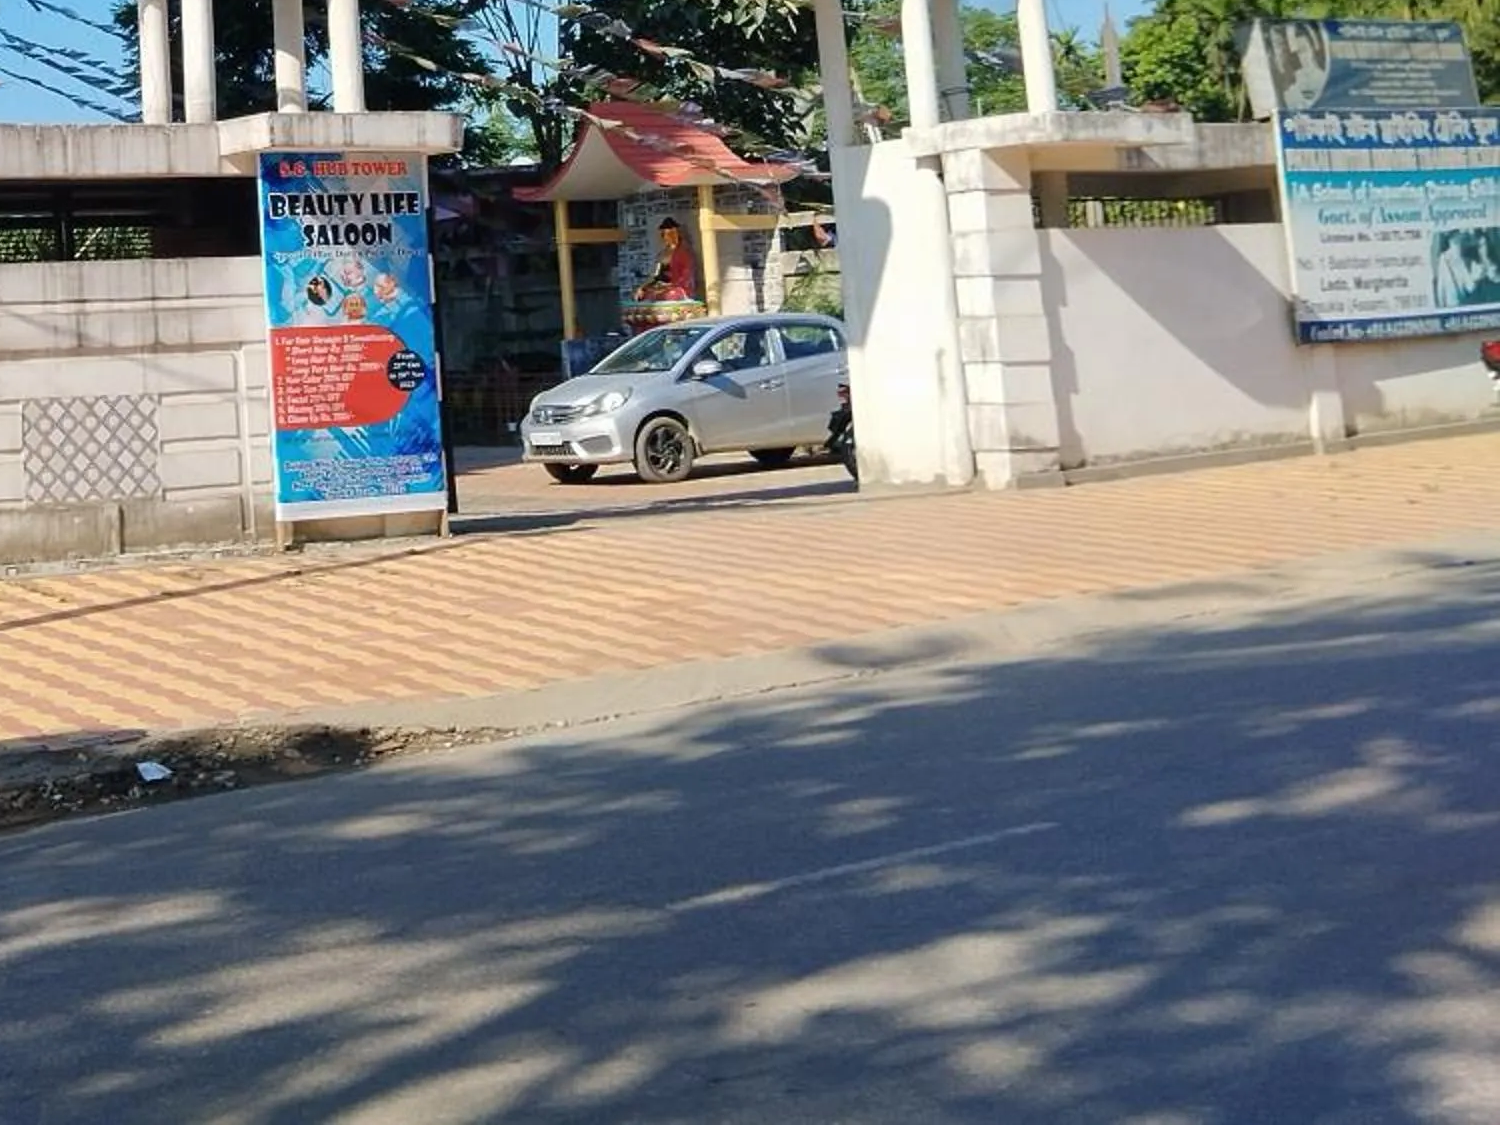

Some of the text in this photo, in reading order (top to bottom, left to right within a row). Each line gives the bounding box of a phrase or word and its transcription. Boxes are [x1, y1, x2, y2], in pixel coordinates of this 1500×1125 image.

[312, 159, 347, 177] HUB
[350, 158, 409, 177] TOWER
[268, 191, 420, 219] BEAUTY LIFE
[1425, 203, 1487, 226] Approved
[302, 221, 394, 247] SALOON
